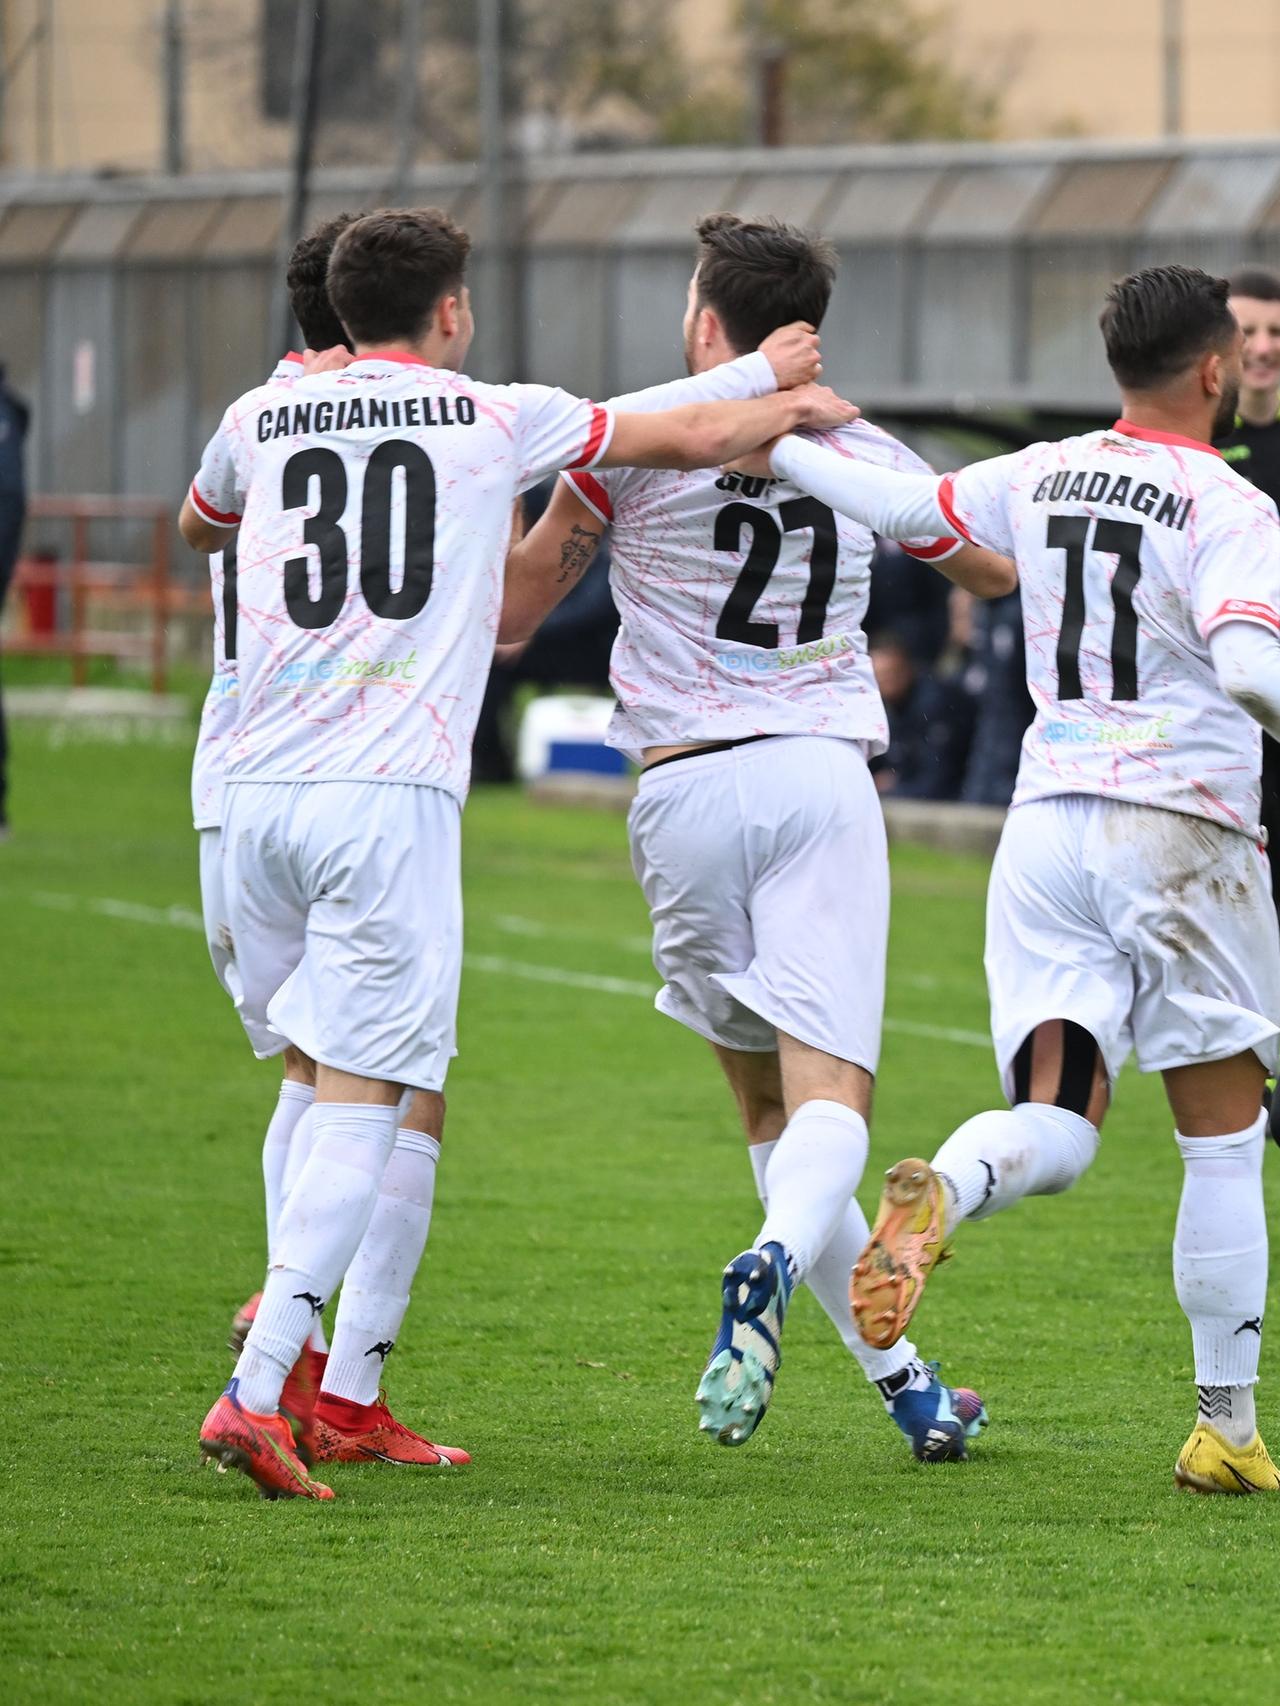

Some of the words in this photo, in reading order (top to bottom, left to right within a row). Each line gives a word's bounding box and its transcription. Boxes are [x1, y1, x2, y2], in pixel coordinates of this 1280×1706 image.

[257, 395, 476, 443] CANGIANIELLO
[1033, 470, 1194, 531] GUADAGNI
[282, 439, 437, 630] 30
